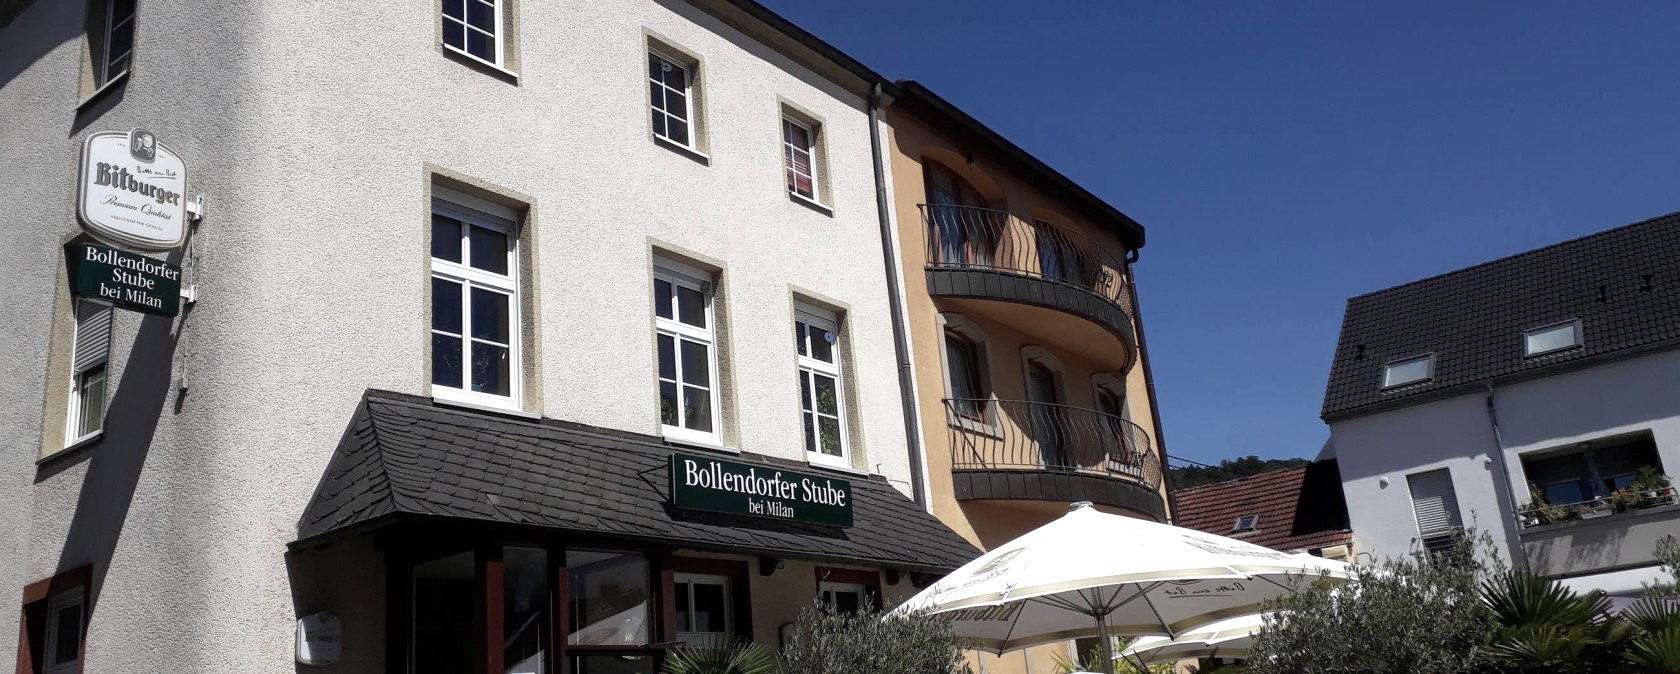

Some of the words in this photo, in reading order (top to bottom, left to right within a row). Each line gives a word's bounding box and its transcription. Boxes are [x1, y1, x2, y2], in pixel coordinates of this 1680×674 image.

[94, 161, 180, 206] Bitburger
[99, 194, 138, 211] Premium
[86, 246, 179, 281] Bollendorfer
[112, 269, 155, 290] Stube
[100, 283, 121, 299] bei
[125, 289, 162, 309] Milan
[684, 459, 797, 499] Bollendorfer
[801, 478, 846, 507] Stube
[749, 497, 764, 514] bei
[766, 500, 794, 518] Milan
